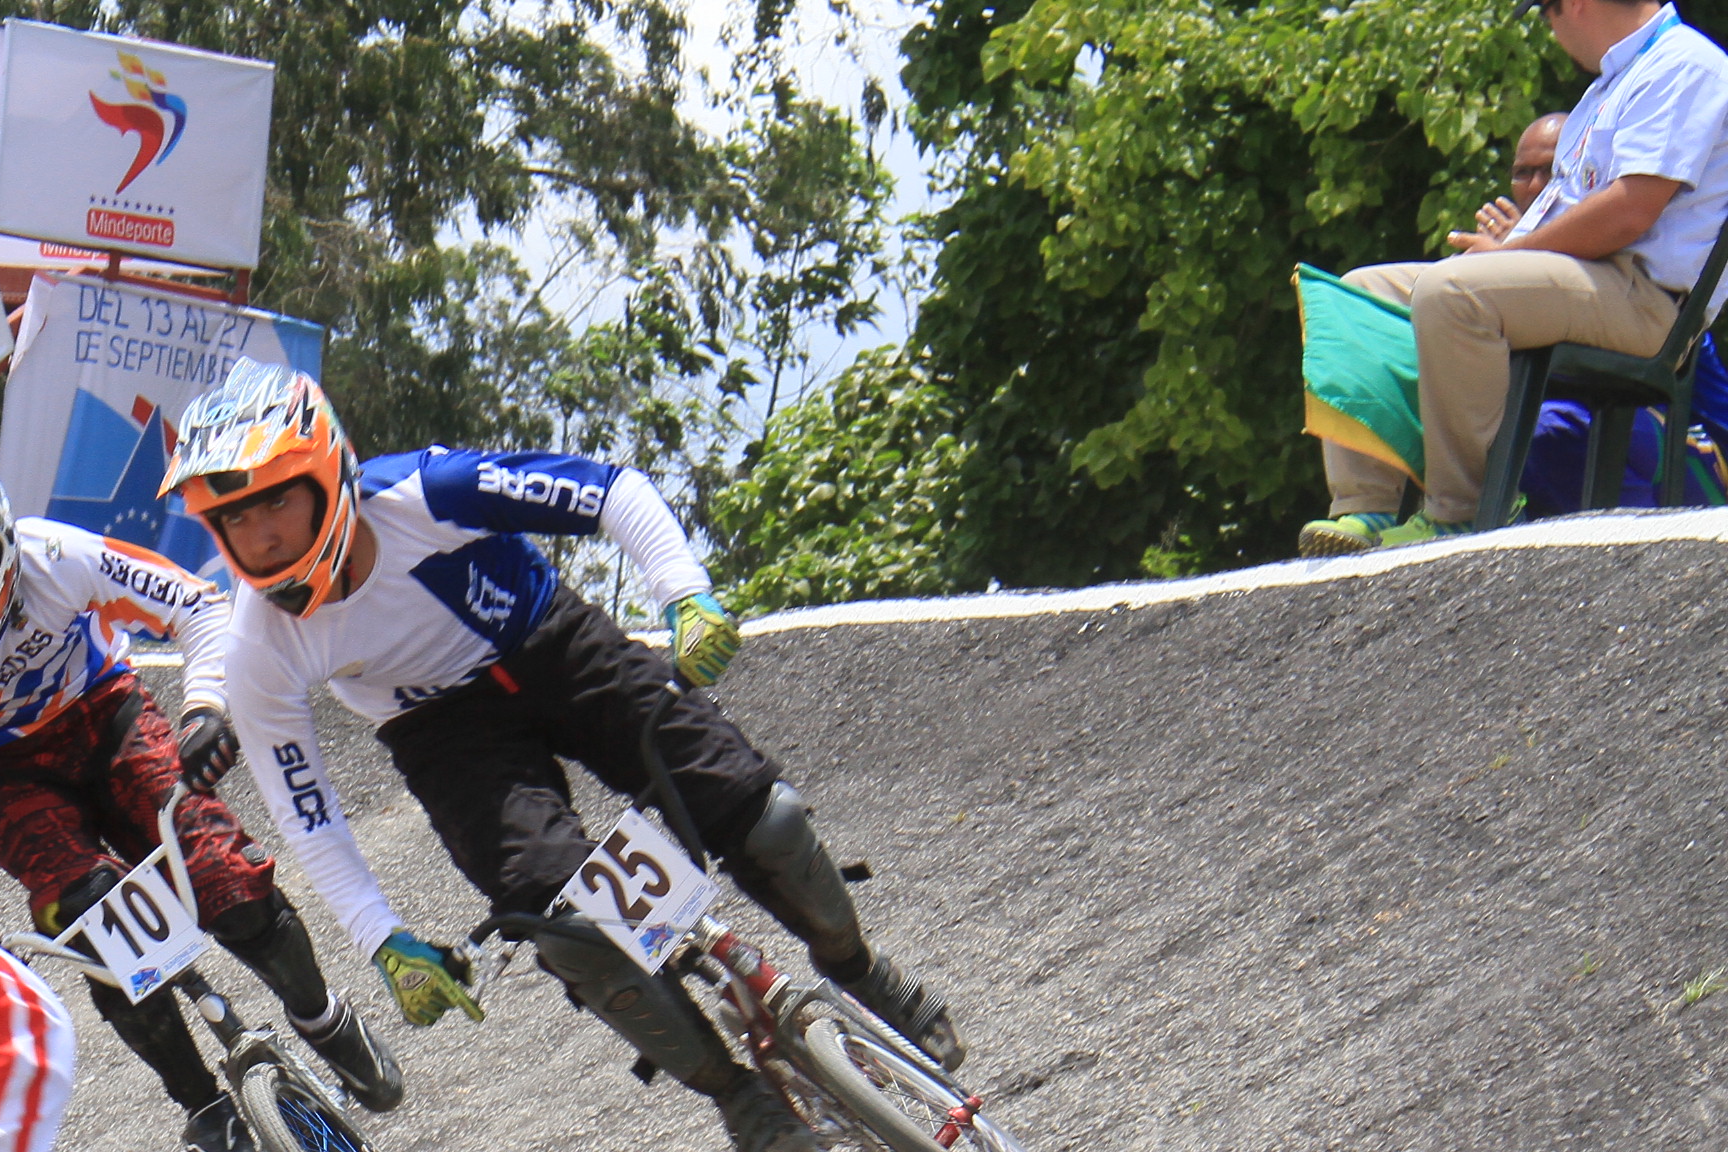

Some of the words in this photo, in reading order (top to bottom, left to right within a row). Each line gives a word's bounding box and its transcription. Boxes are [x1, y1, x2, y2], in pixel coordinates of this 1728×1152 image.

[90, 213, 173, 244] Mindeporte
[78, 285, 129, 329] DEL
[140, 297, 173, 336] 13
[180, 304, 211, 344] AL
[219, 313, 256, 351] 27
[75, 330, 103, 364] DE
[106, 334, 238, 386] SEPTIEMBR
[477, 460, 605, 519] SUCRE
[580, 828, 672, 934] 25
[100, 881, 171, 960] 10
